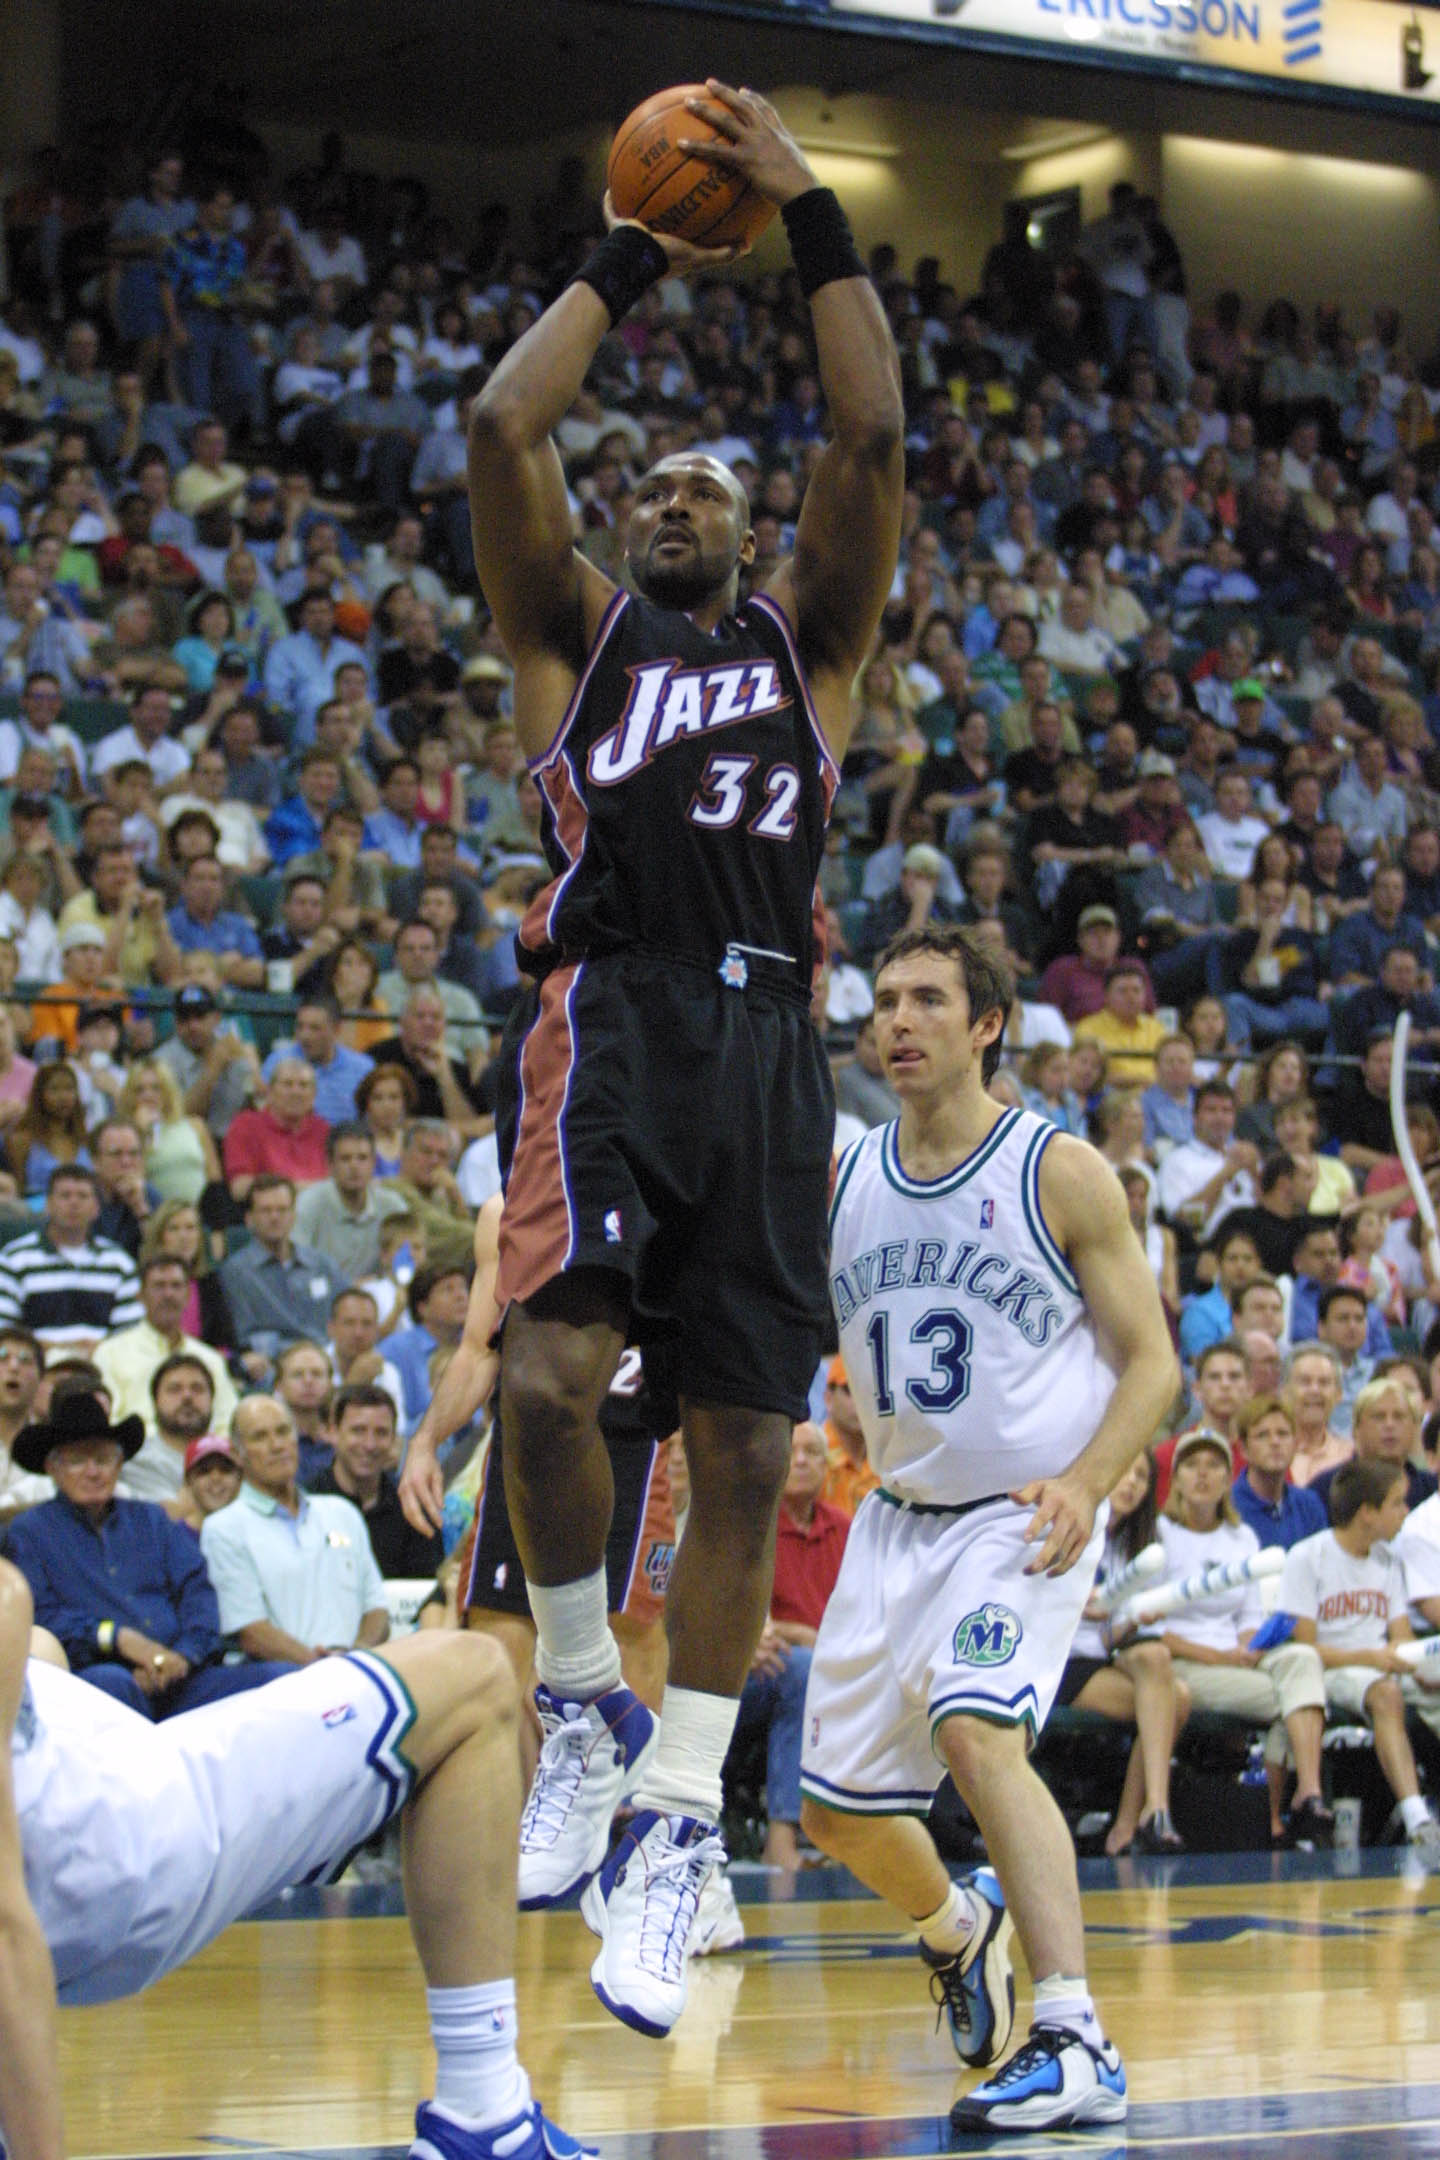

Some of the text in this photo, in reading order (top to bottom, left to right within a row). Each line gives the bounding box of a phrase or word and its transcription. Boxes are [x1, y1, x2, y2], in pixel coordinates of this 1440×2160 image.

[638, 136, 670, 169] NBA
[587, 657, 790, 787] JAZZ
[686, 752, 800, 841] 32
[829, 1238, 1064, 1348] AVERICKS
[866, 1307, 973, 1417] 13
[963, 1620, 1004, 1656] M
